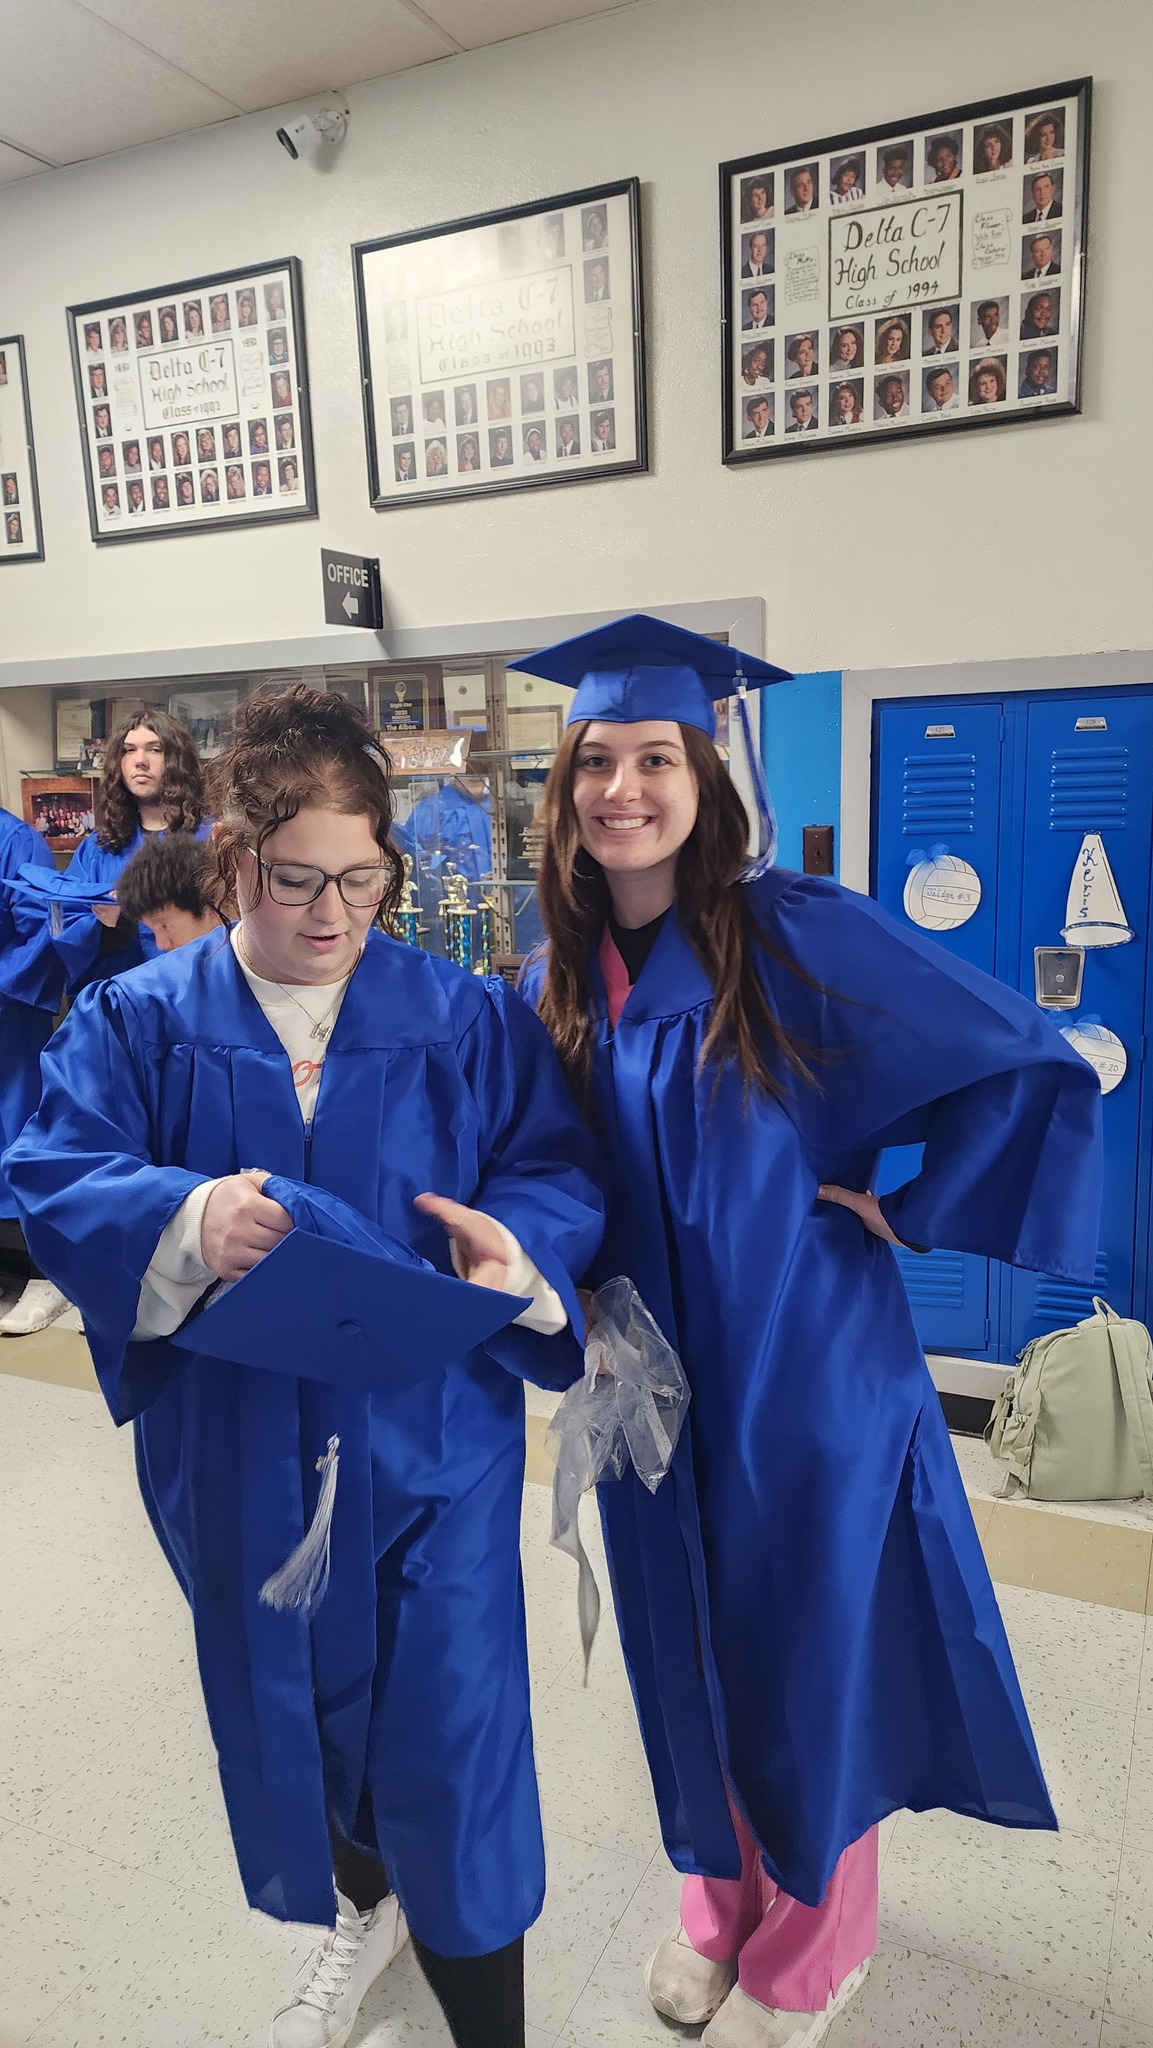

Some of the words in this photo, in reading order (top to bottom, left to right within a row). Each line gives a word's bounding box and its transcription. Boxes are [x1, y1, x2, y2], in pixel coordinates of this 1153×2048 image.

[844, 215, 903, 252] Delta
[910, 203, 951, 238] C-7
[834, 254, 877, 291] High
[886, 241, 945, 277] School
[425, 292, 504, 328] Delta
[518, 276, 559, 311] C-7
[845, 294, 877, 309] Class
[883, 290, 897, 308] of
[907, 280, 939, 299] 1994
[426, 326, 481, 354] High
[490, 309, 563, 341] School
[148, 356, 193, 381] Delta
[198, 347, 225, 373] C-7
[438, 353, 491, 373] Class
[499, 349, 510, 359] of
[514, 337, 556, 360] 1993
[151, 383, 182, 404] High
[187, 372, 229, 397] School
[162, 405, 191, 420] Class
[199, 400, 221, 415] 1992
[327, 562, 369, 588] OFFICE
